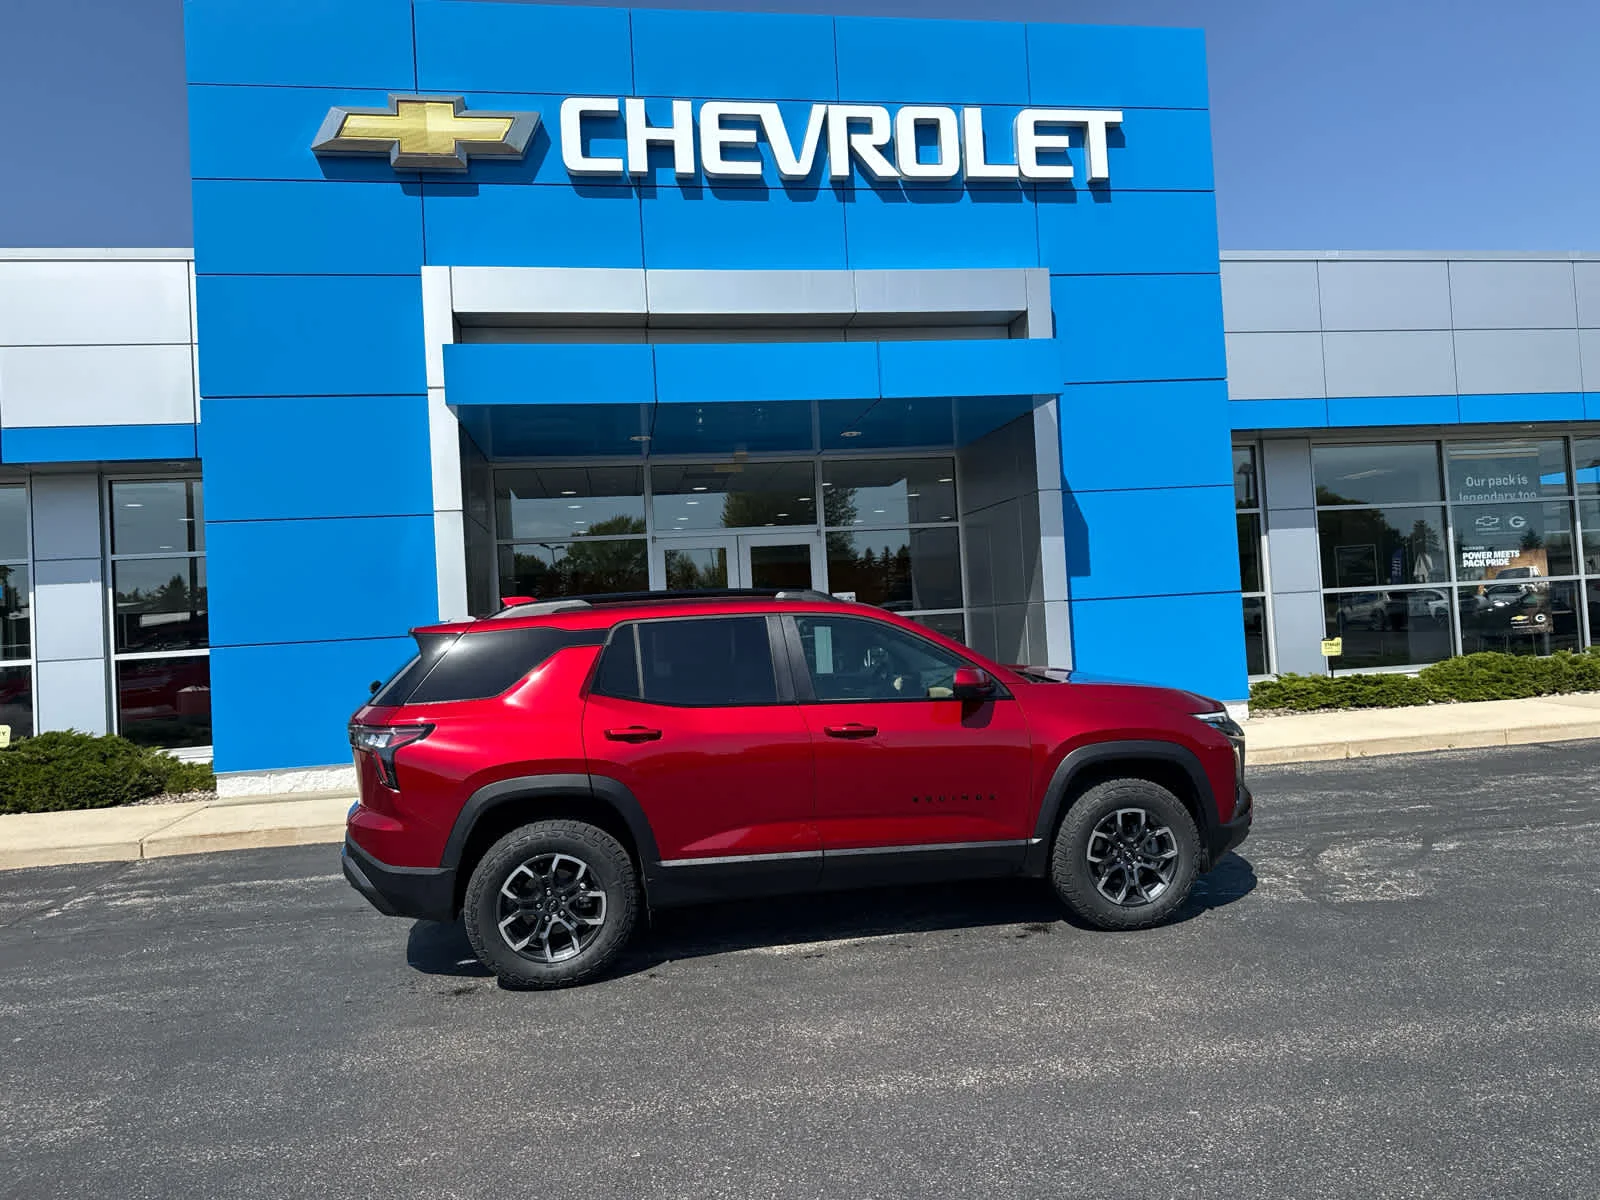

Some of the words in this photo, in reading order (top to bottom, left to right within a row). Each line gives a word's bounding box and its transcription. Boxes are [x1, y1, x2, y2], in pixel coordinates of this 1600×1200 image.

[560, 97, 1124, 182] CHEVROLET
[1466, 476, 1486, 487] Our
[1488, 474, 1516, 488] pack
[1517, 473, 1528, 485] is
[1462, 551, 1492, 560] POWER
[1493, 550, 1520, 559] MEETS
[1463, 559, 1485, 567] PACK
[1486, 558, 1510, 567] PRIDE
